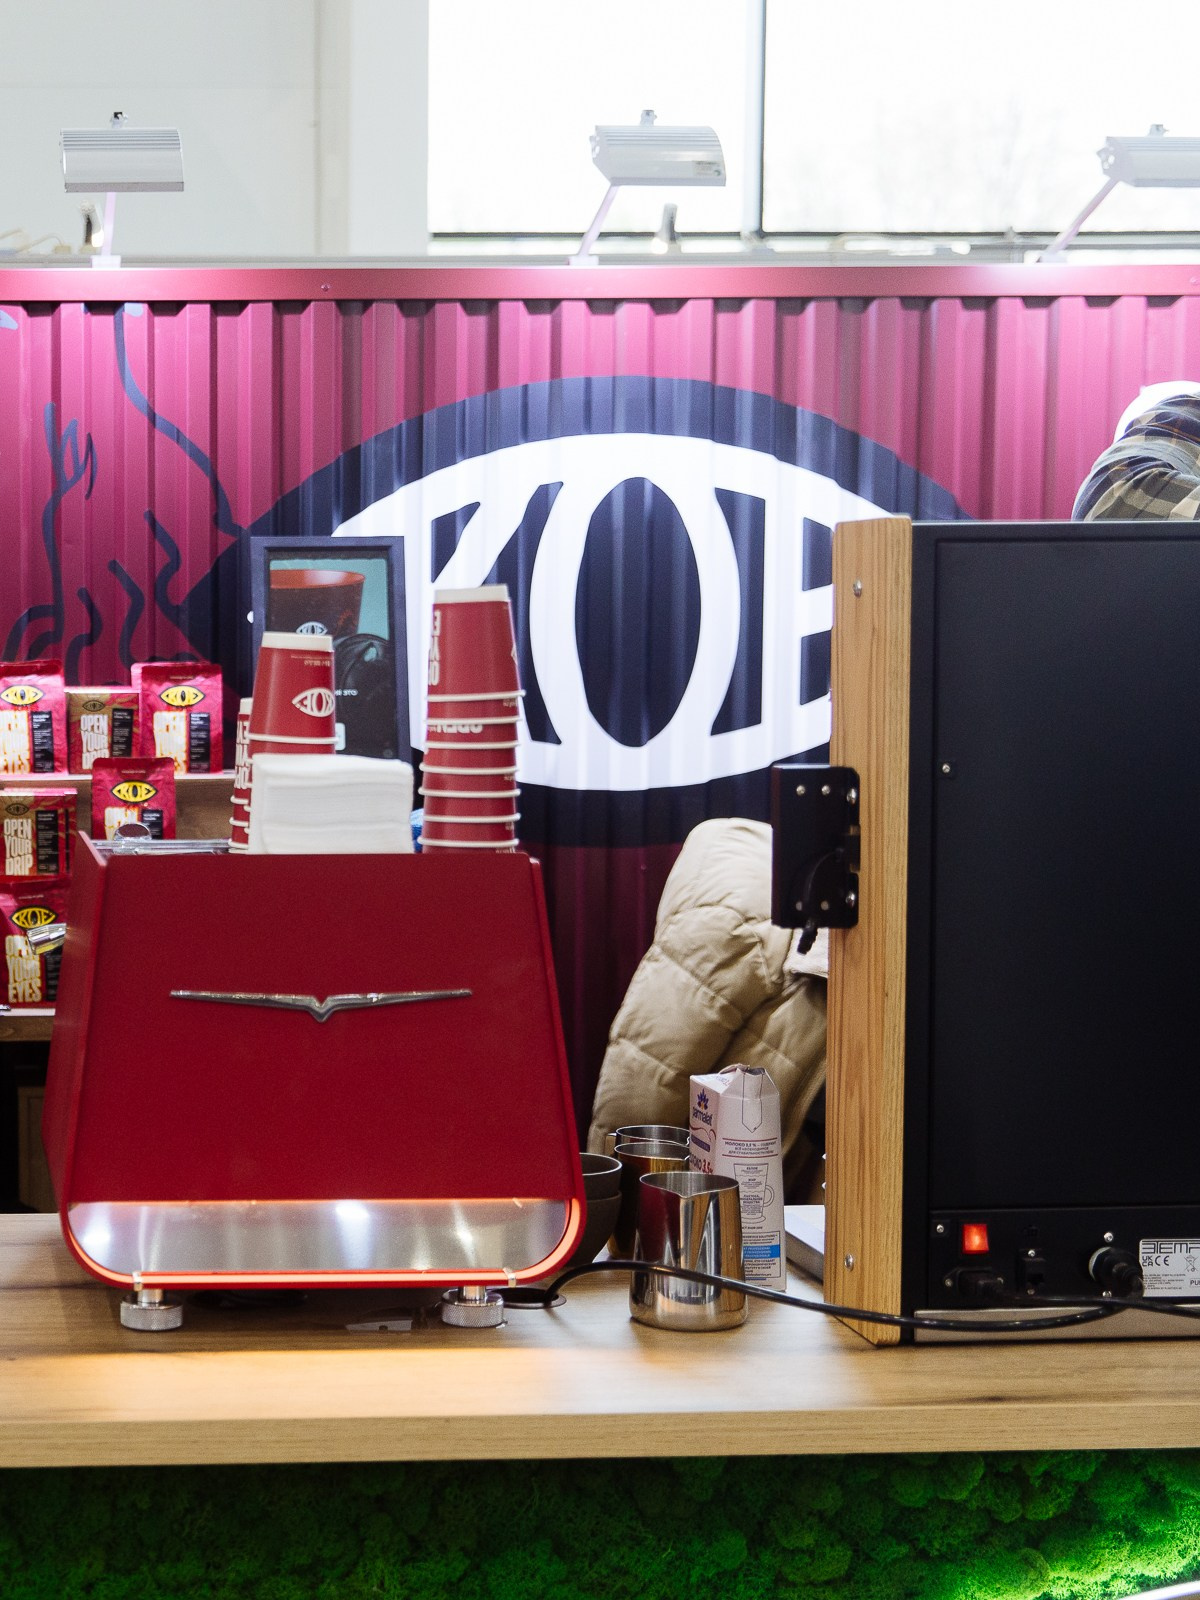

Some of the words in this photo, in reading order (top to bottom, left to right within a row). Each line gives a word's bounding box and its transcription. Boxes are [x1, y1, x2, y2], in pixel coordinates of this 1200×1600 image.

[81, 715, 109, 736] OPEN
[81, 730, 109, 753] YOUR
[3, 818, 32, 839] OPEN
[4, 834, 33, 858] YOUR
[5, 855, 34, 876] DRIP
[7, 953, 41, 984] YOUR
[8, 977, 42, 1004] EYES
